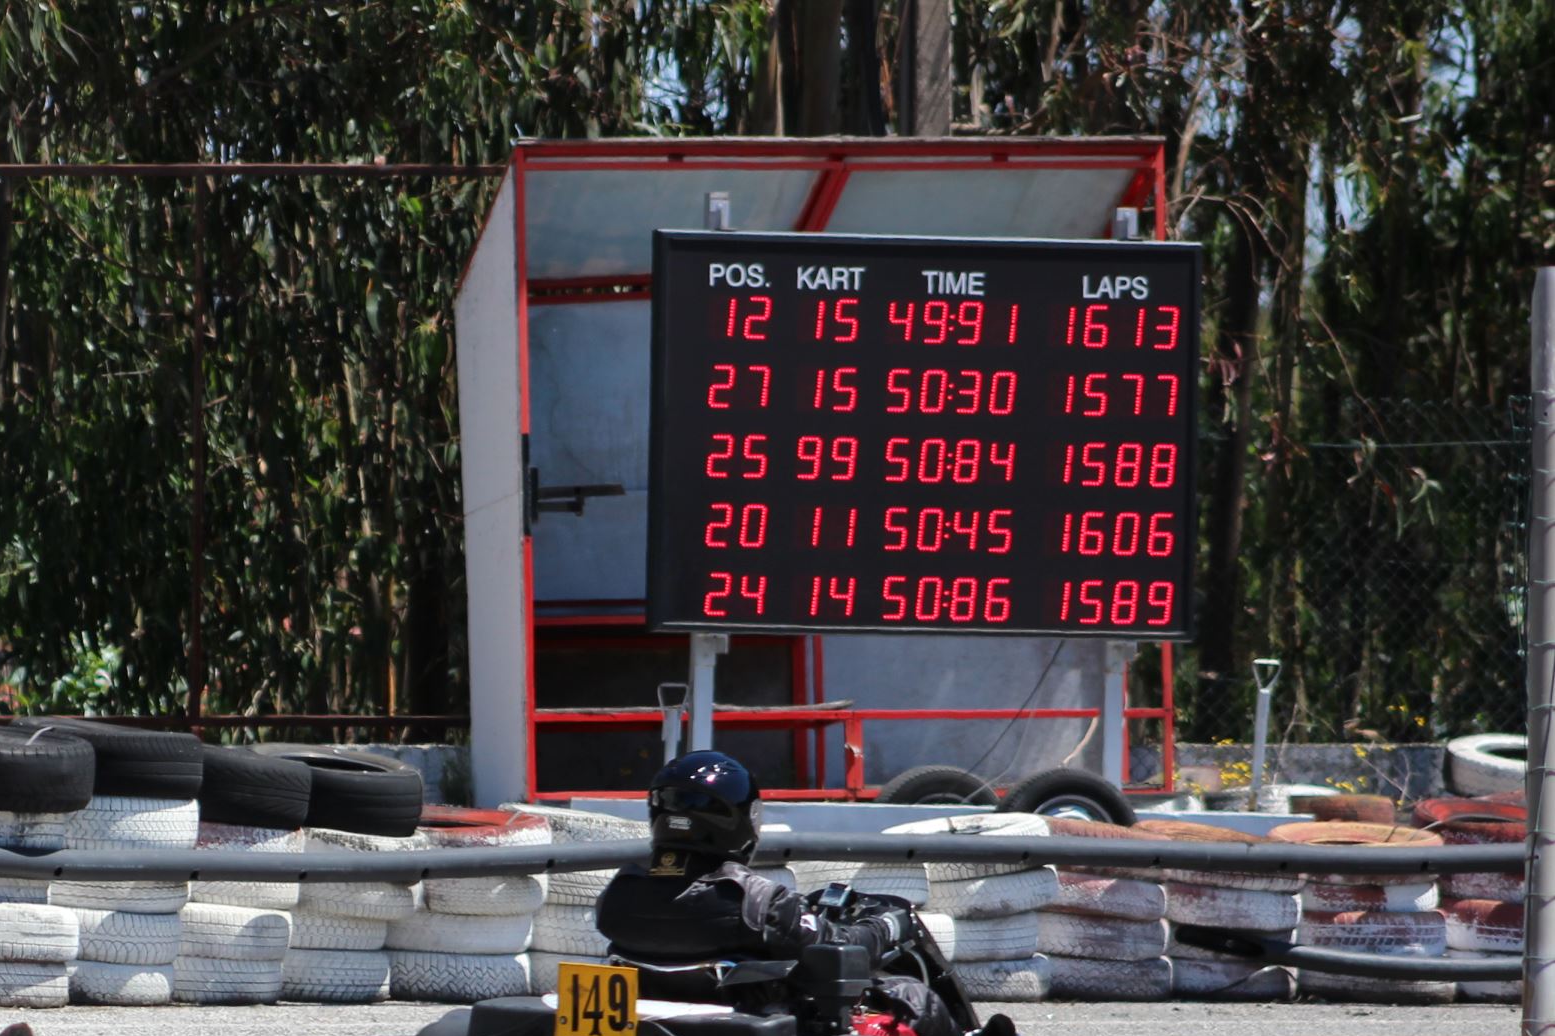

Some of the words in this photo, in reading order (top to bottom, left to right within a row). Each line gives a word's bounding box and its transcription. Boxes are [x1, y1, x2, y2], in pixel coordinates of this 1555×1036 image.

[709, 263, 771, 289] POS.
[797, 266, 866, 291] KART
[921, 270, 986, 297] TIME
[1082, 275, 1149, 301] LAPS
[726, 295, 773, 342] 12
[814, 297, 860, 344] 15
[888, 299, 1019, 347] 49:91
[1066, 303, 1181, 352] 1613
[707, 363, 772, 410] 27
[813, 366, 858, 414] 15
[886, 367, 1018, 417] 50:30
[1064, 372, 1179, 418] 1577
[705, 432, 769, 480] 25
[796, 435, 859, 482] 99
[884, 436, 1017, 485] 50:84
[1062, 441, 1178, 490] 1588
[704, 501, 769, 549] 20
[811, 506, 858, 549] 11
[883, 506, 1013, 555] 50:45
[1061, 510, 1175, 559] 1606
[702, 571, 768, 618] 24
[809, 575, 857, 619] 14
[881, 574, 1011, 624] 50:86
[1059, 580, 1175, 627] 1589
[571, 973, 630, 1036] 149
